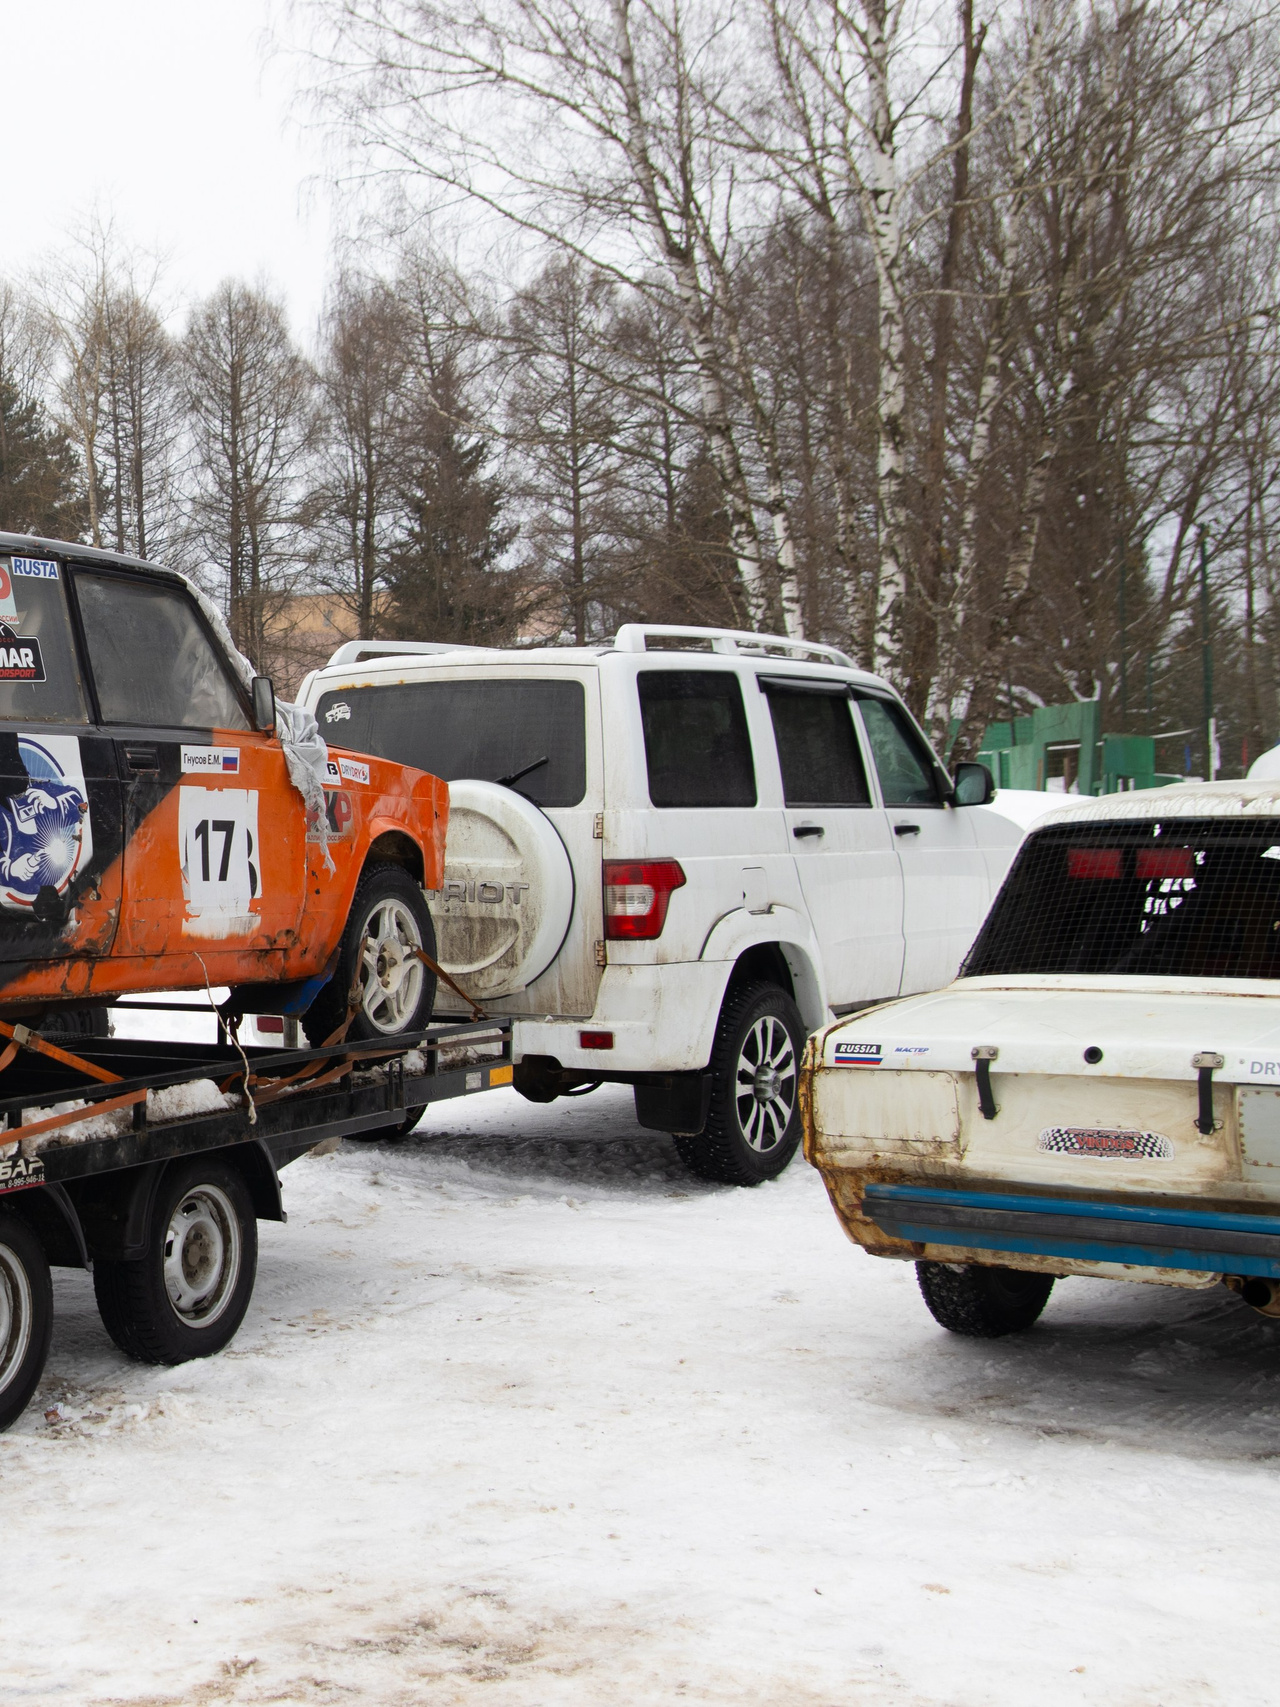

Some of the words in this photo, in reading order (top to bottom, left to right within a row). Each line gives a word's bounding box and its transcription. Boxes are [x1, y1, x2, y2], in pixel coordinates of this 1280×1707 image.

[14, 559, 57, 578] RUSTA
[183, 753, 207, 766] Гнусов
[194, 819, 235, 882] 17
[839, 1044, 877, 1053] RUSSIA
[1075, 1135, 1135, 1150] VIKINGS
